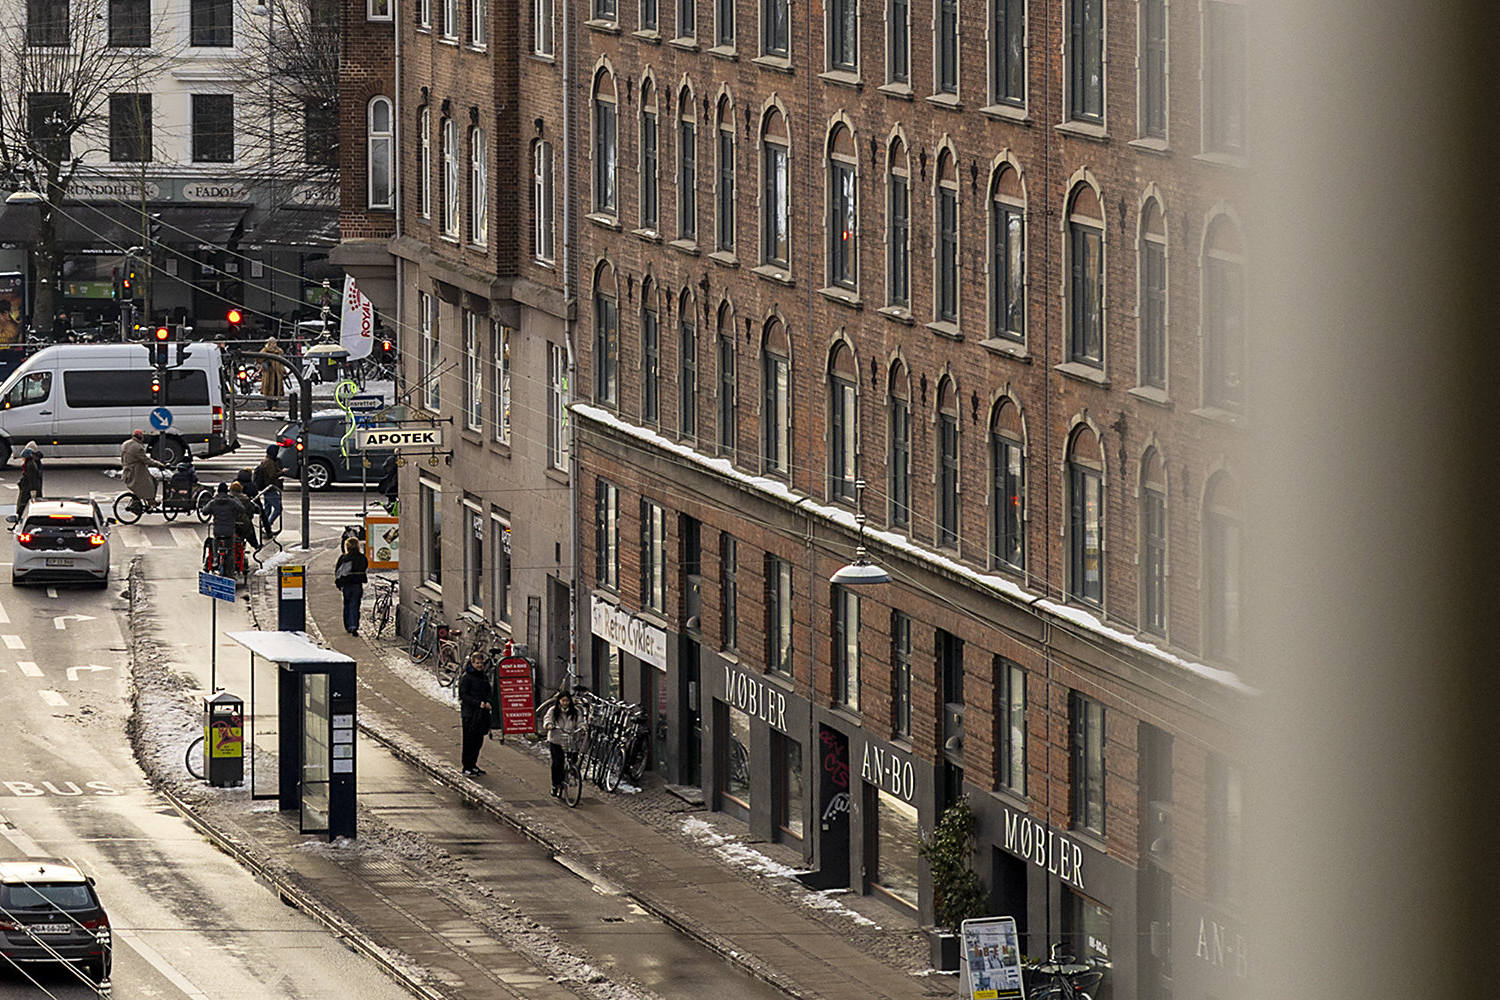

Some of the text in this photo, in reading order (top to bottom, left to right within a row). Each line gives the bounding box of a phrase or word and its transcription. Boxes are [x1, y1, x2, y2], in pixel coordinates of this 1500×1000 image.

[361, 302, 371, 337] ROYAL
[366, 432, 435, 445] APOTEK
[604, 607, 654, 655] Retro Cykler
[725, 666, 788, 732] MØBLER
[2, 780, 124, 797] BUS
[861, 741, 914, 801] AN-BO
[1004, 808, 1084, 889] MØBLER
